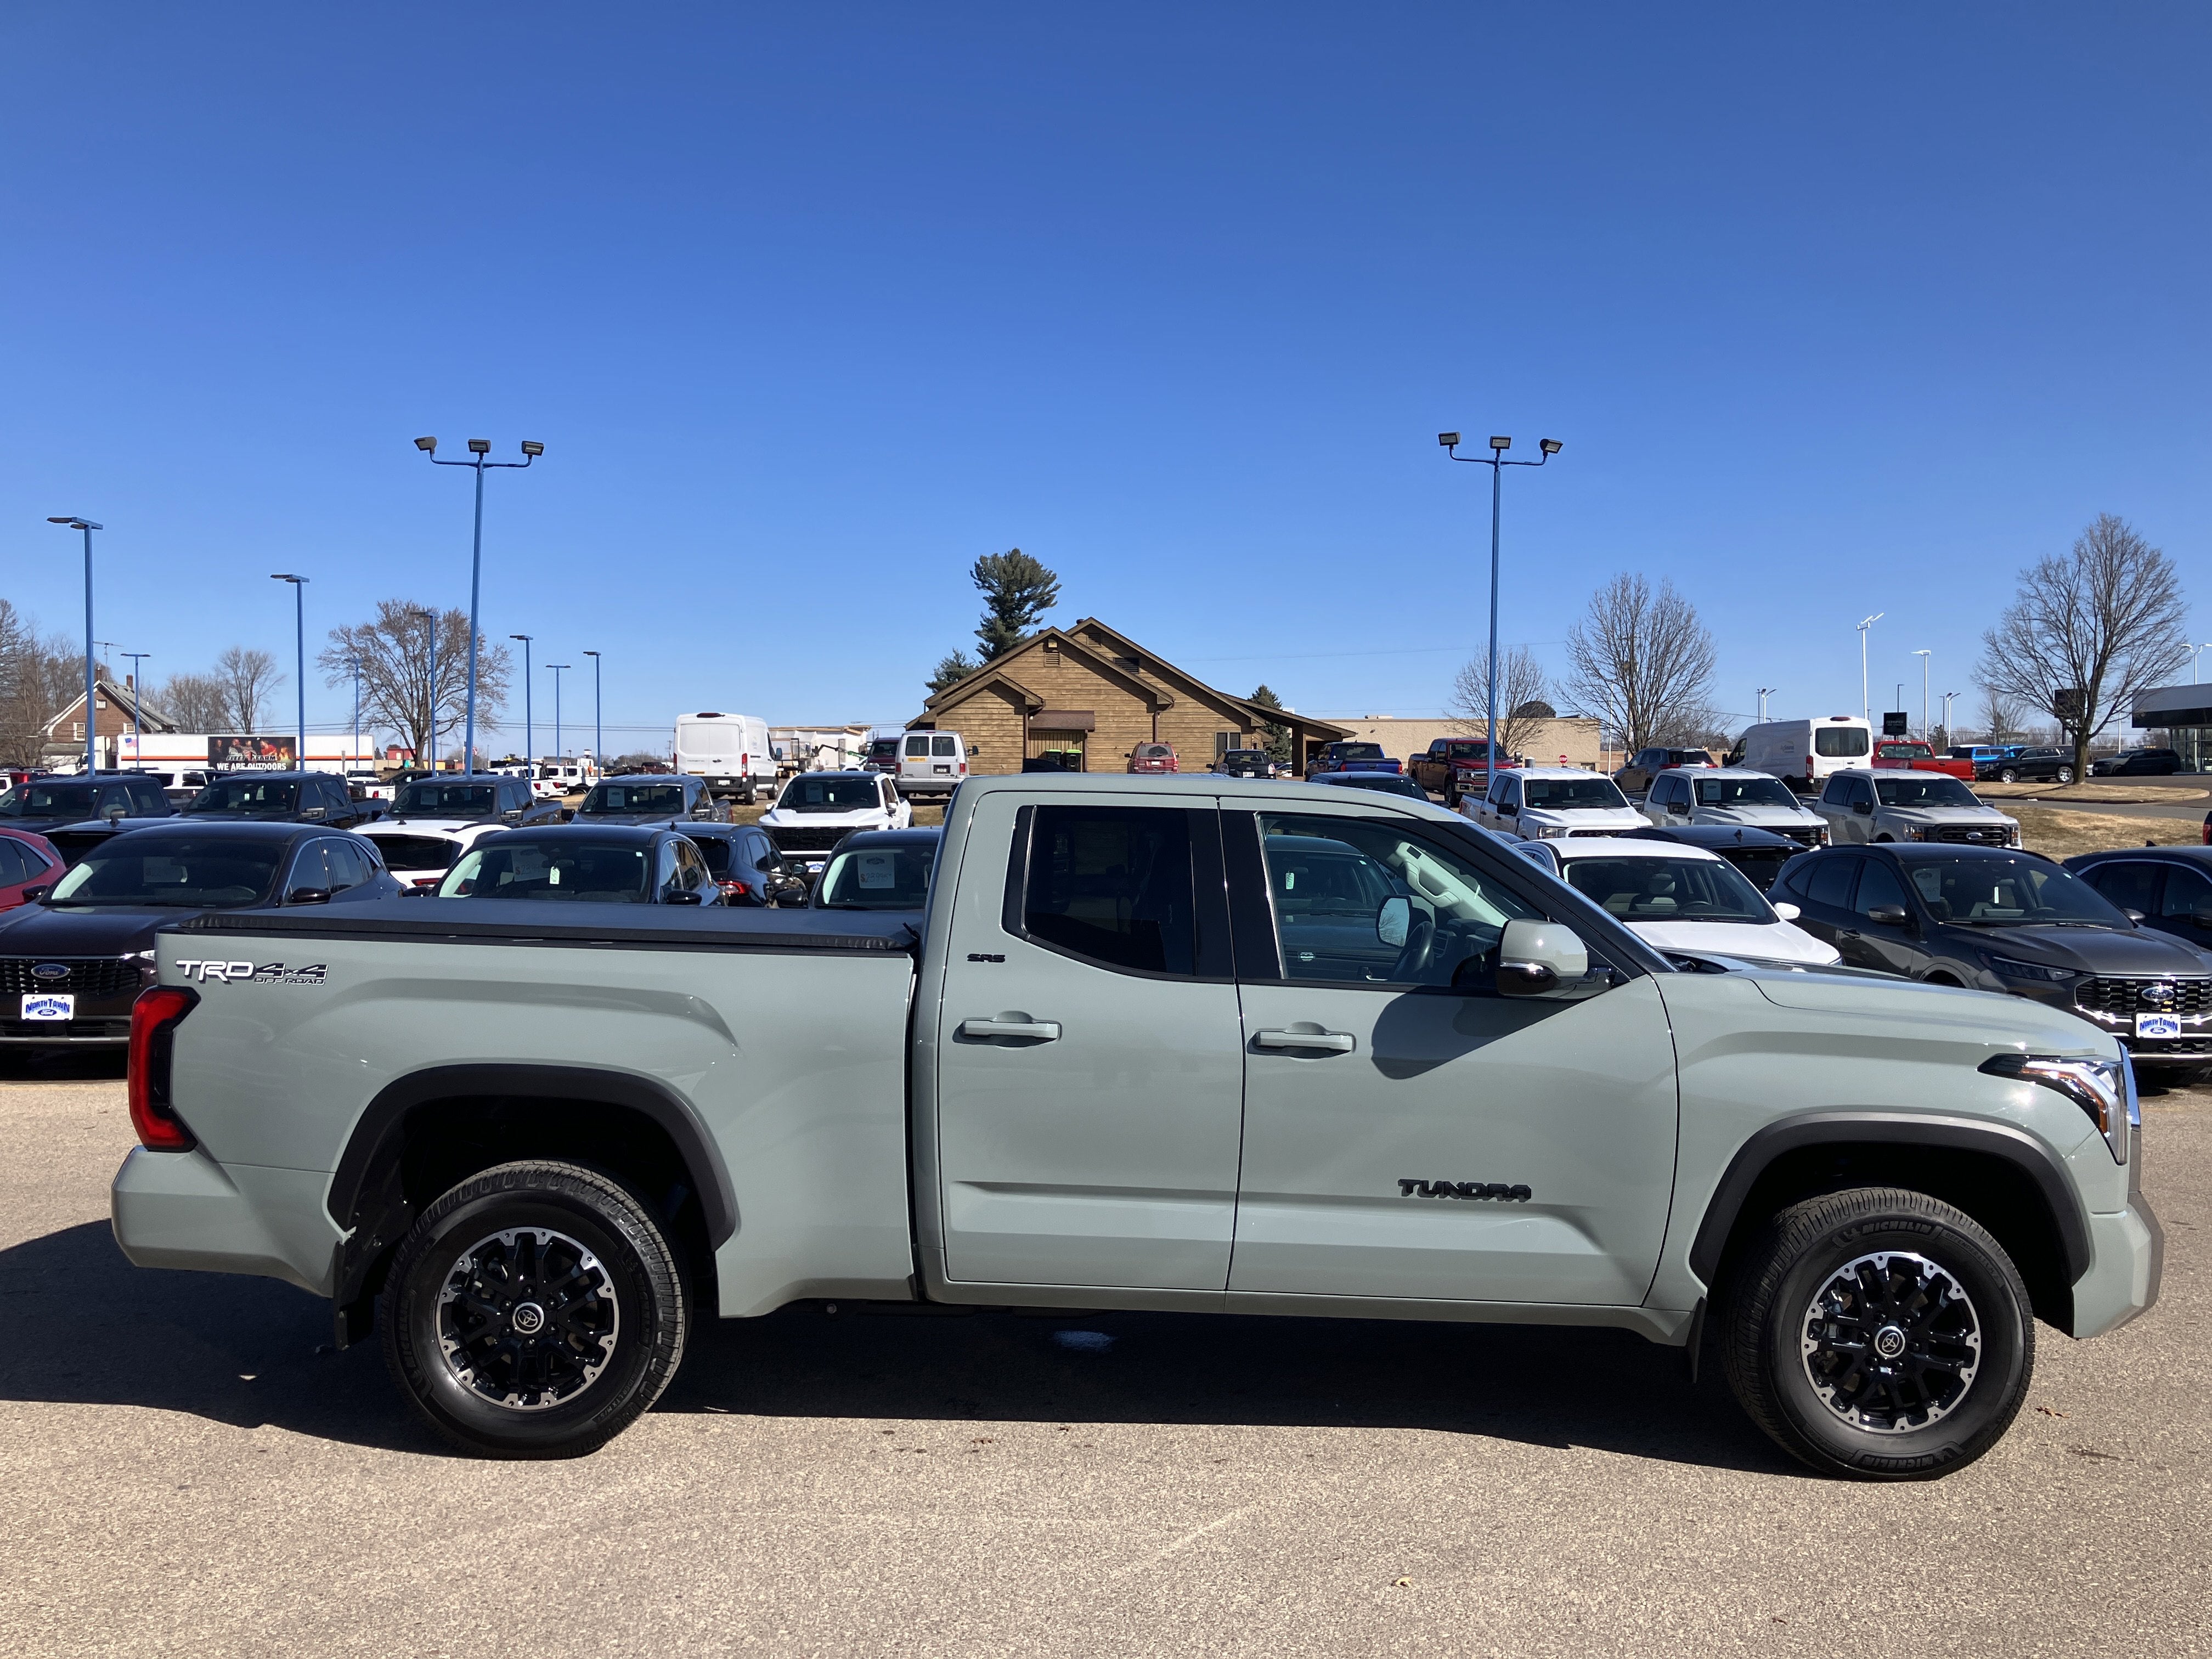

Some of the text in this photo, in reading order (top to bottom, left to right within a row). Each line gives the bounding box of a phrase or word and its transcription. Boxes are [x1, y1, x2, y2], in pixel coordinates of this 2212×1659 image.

[231, 763, 245, 771] ARE
[247, 763, 287, 771] OUTDOORS
[176, 960, 329, 982] TRD 4x4
[284, 978, 326, 986] ROAD
[25, 998, 70, 1014] NORTH TOWN
[1397, 1179, 1532, 1201] TUNDRA
[1862, 1221, 1932, 1234] MICHELIN
